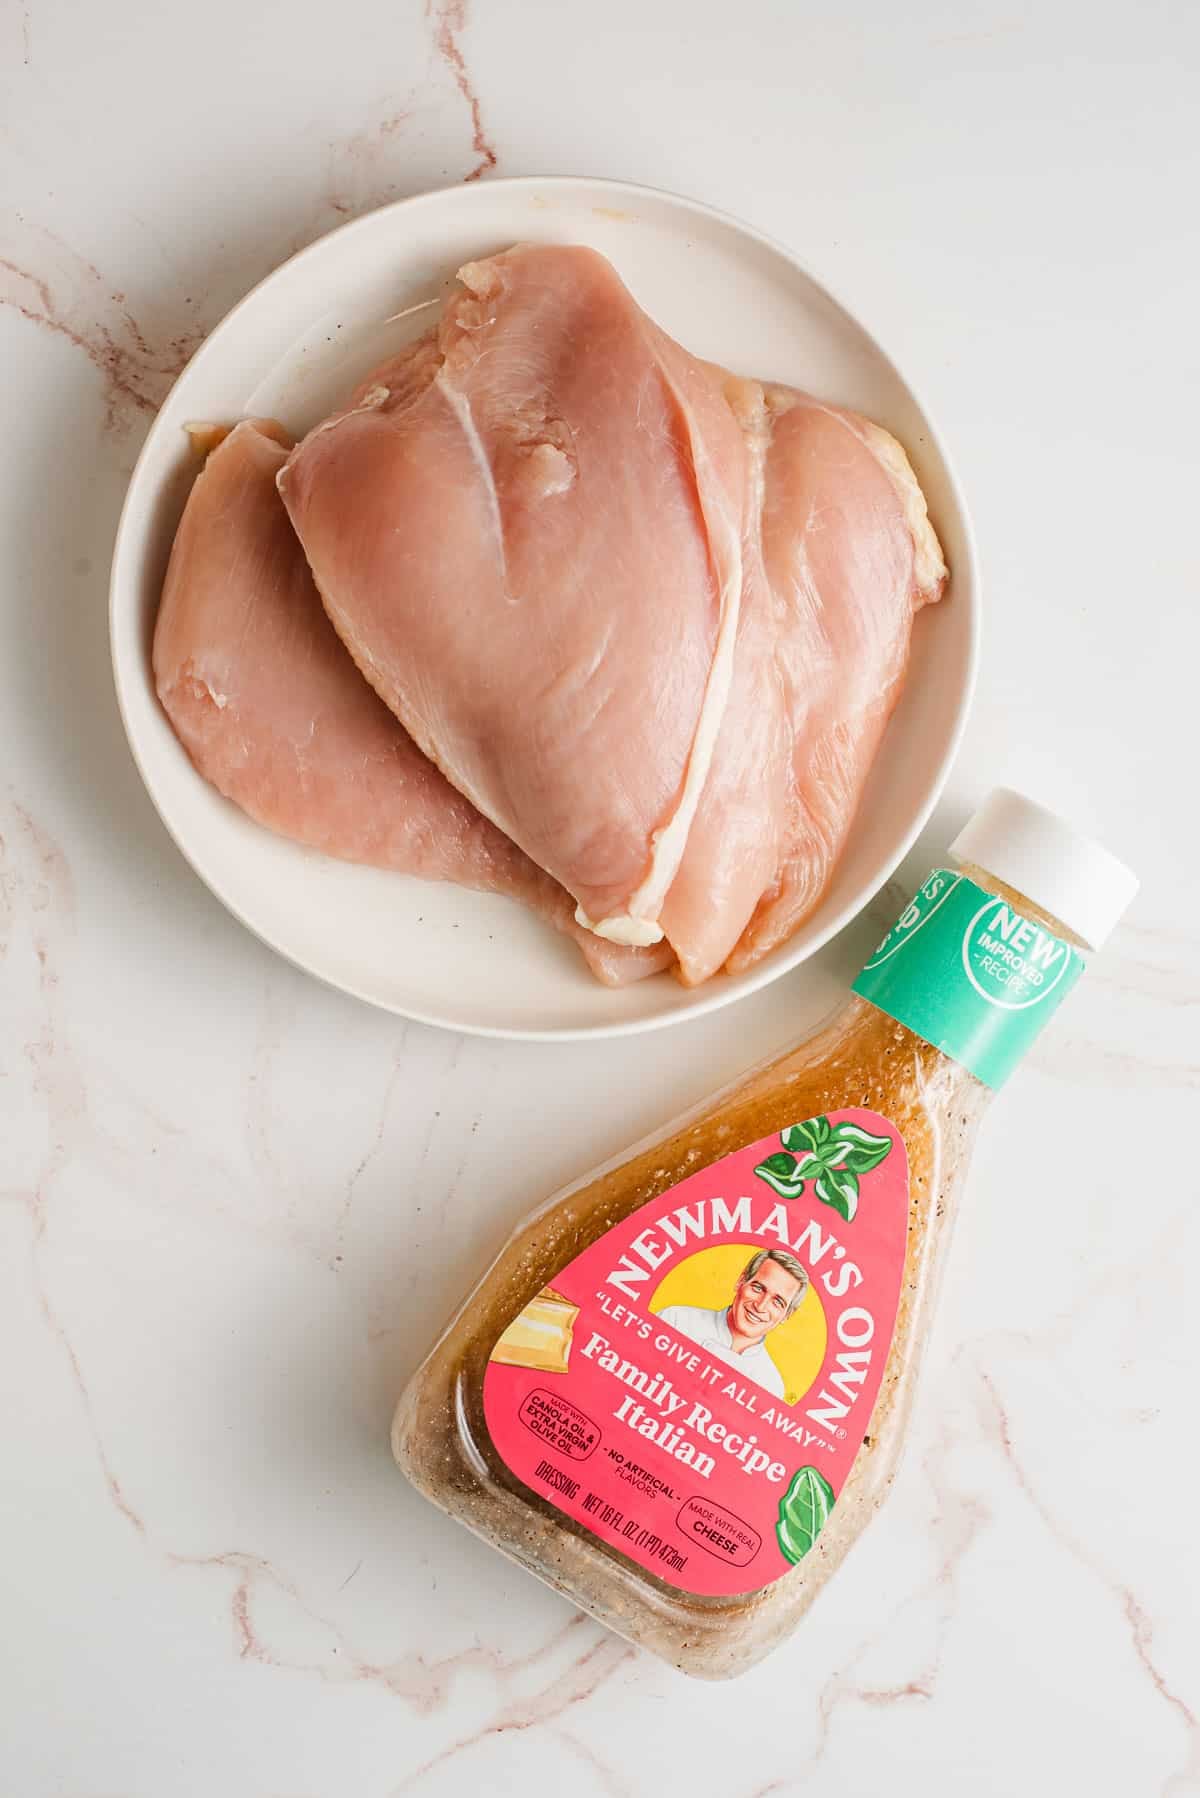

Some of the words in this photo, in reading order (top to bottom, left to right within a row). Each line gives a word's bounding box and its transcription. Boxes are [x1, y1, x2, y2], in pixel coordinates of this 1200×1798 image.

[977, 932, 1044, 986] IMPROVED
[988, 906, 1065, 969] NEW
[605, 1197, 864, 1301] NEWMAN'S
[655, 1335, 701, 1372] GIVE
[700, 1365, 724, 1385] IT
[721, 1382, 760, 1413] ALL
[526, 1404, 557, 1430] EXTRA
[557, 1426, 589, 1452] VIRGIN
[531, 1396, 569, 1427] CANOLA
[570, 1423, 585, 1439] OIL
[586, 1434, 594, 1444] &
[550, 1398, 570, 1414] MADE
[569, 1410, 588, 1426] WITH
[579, 1332, 688, 1417] Family
[683, 1402, 788, 1482] Recipe
[530, 1420, 558, 1443] OLIVE
[557, 1439, 573, 1454] OIL
[613, 1395, 717, 1479] Italian
[534, 1460, 581, 1500] DRESSING
[615, 1466, 658, 1500] FLAVORS
[581, 1492, 603, 1515] NET
[599, 1504, 615, 1523] 16
[688, 1502, 714, 1521] MADE
[714, 1516, 738, 1536] WITH
[736, 1532, 755, 1551] REAL
[693, 1520, 739, 1555] CHEESE
